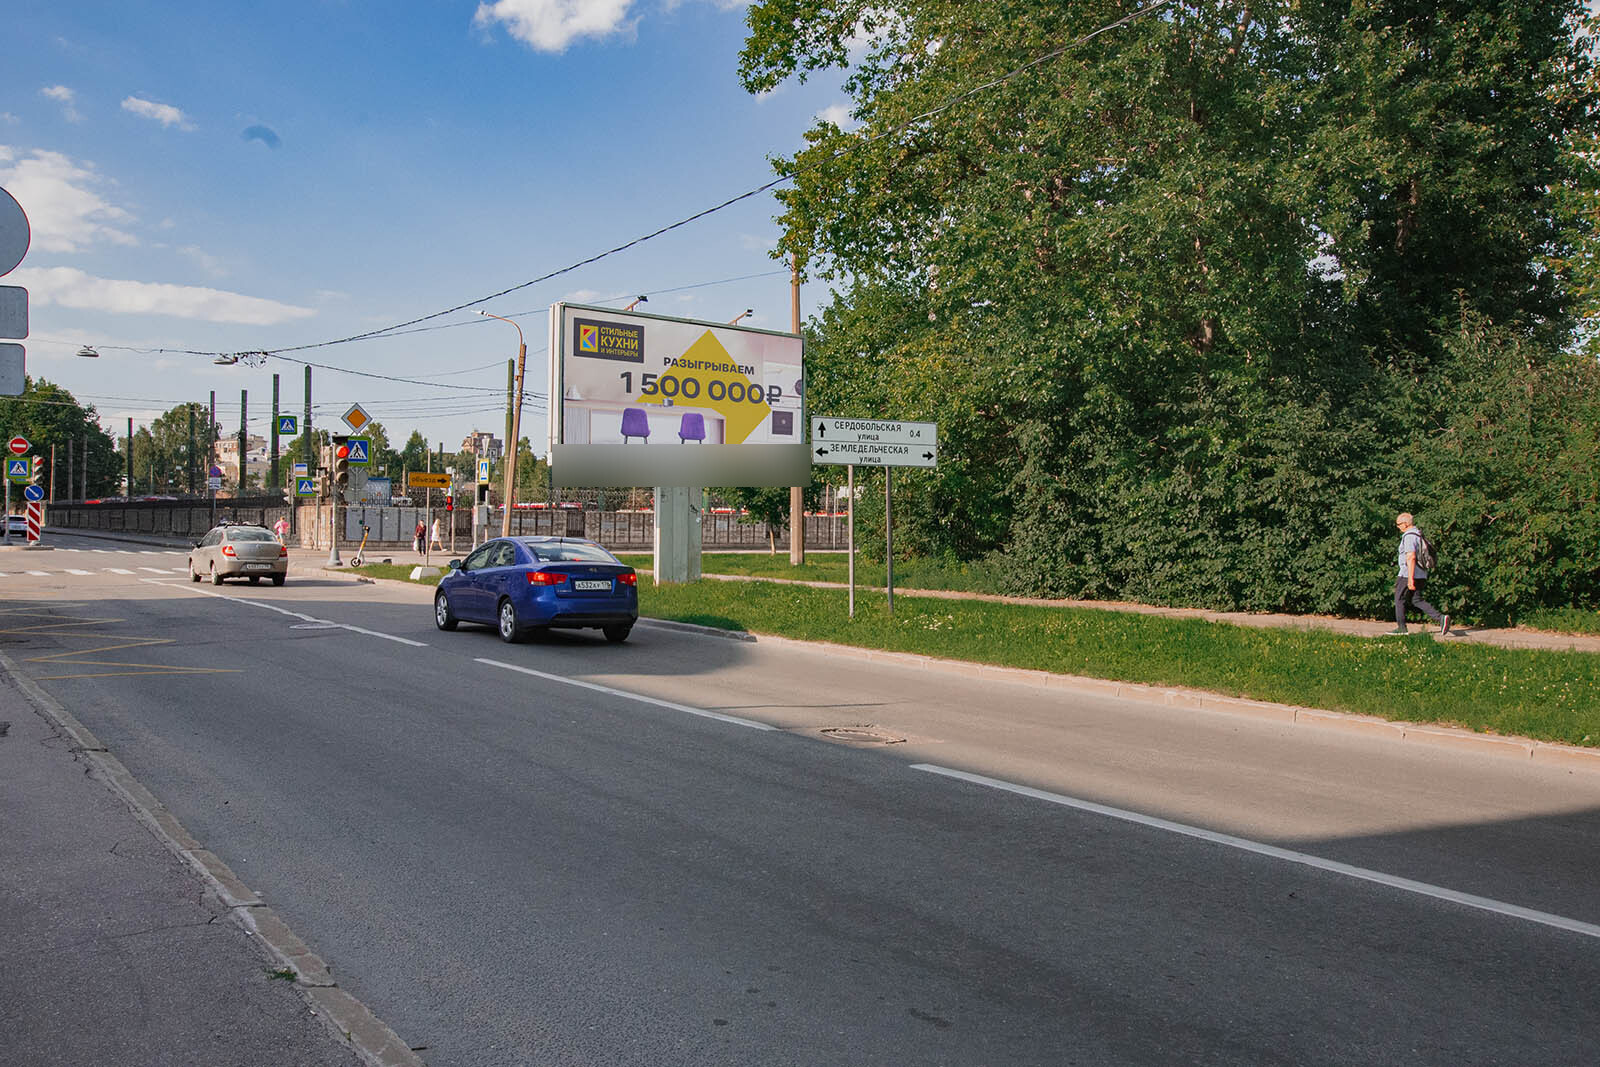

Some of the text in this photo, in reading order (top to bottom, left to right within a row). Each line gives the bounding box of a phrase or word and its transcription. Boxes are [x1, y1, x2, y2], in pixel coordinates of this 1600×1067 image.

[600, 327, 638, 338] СТИЛЬНЫЕ
[600, 336, 638, 350] КУХНИ
[606, 348, 638, 357] ИНТЕРЬЕРЫ
[664, 357, 755, 375] РАЗЫГРЫВАЕМ
[620, 371, 632, 393] 1
[641, 373, 701, 399] 500
[834, 421, 902, 432] СЕРДОБОЛЬСКАЯ
[857, 433, 880, 441] улица
[830, 444, 909, 454] ЗЕМЛЕДЕЛЬЧЕСКАЯ
[859, 456, 881, 464] улица
